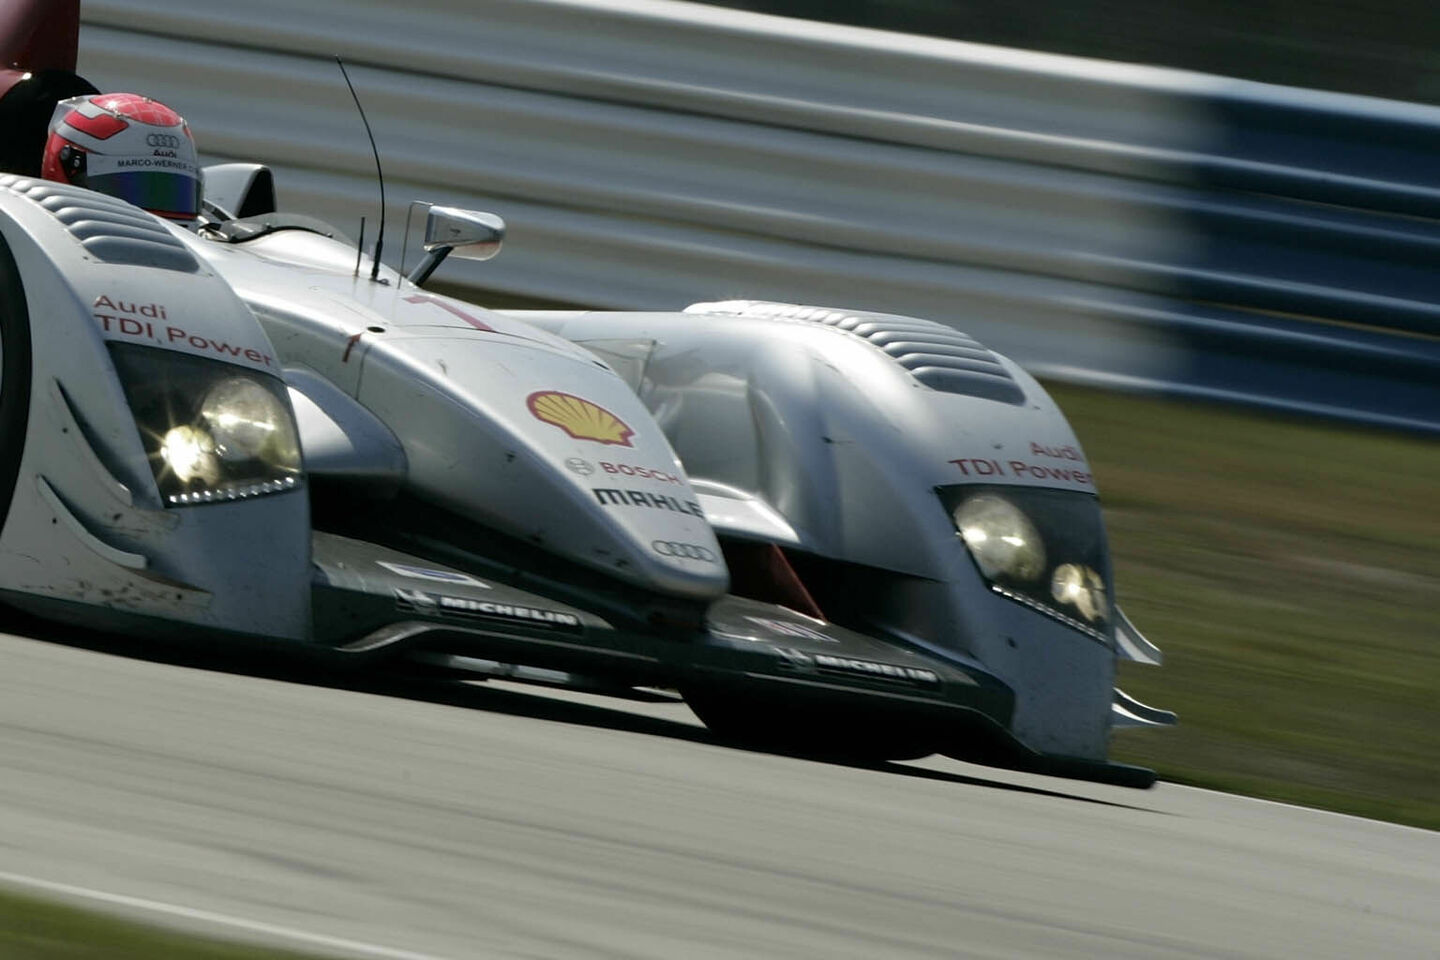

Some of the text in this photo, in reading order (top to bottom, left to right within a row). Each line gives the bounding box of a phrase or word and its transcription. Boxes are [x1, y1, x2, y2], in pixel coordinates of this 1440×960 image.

[93, 294, 167, 320] Audi
[93, 313, 273, 367] TDI Power
[599, 461, 685, 486] BOSCH
[947, 458, 1005, 476] TDI
[592, 488, 706, 520] MAHLE
[440, 596, 578, 626] MICHELIN
